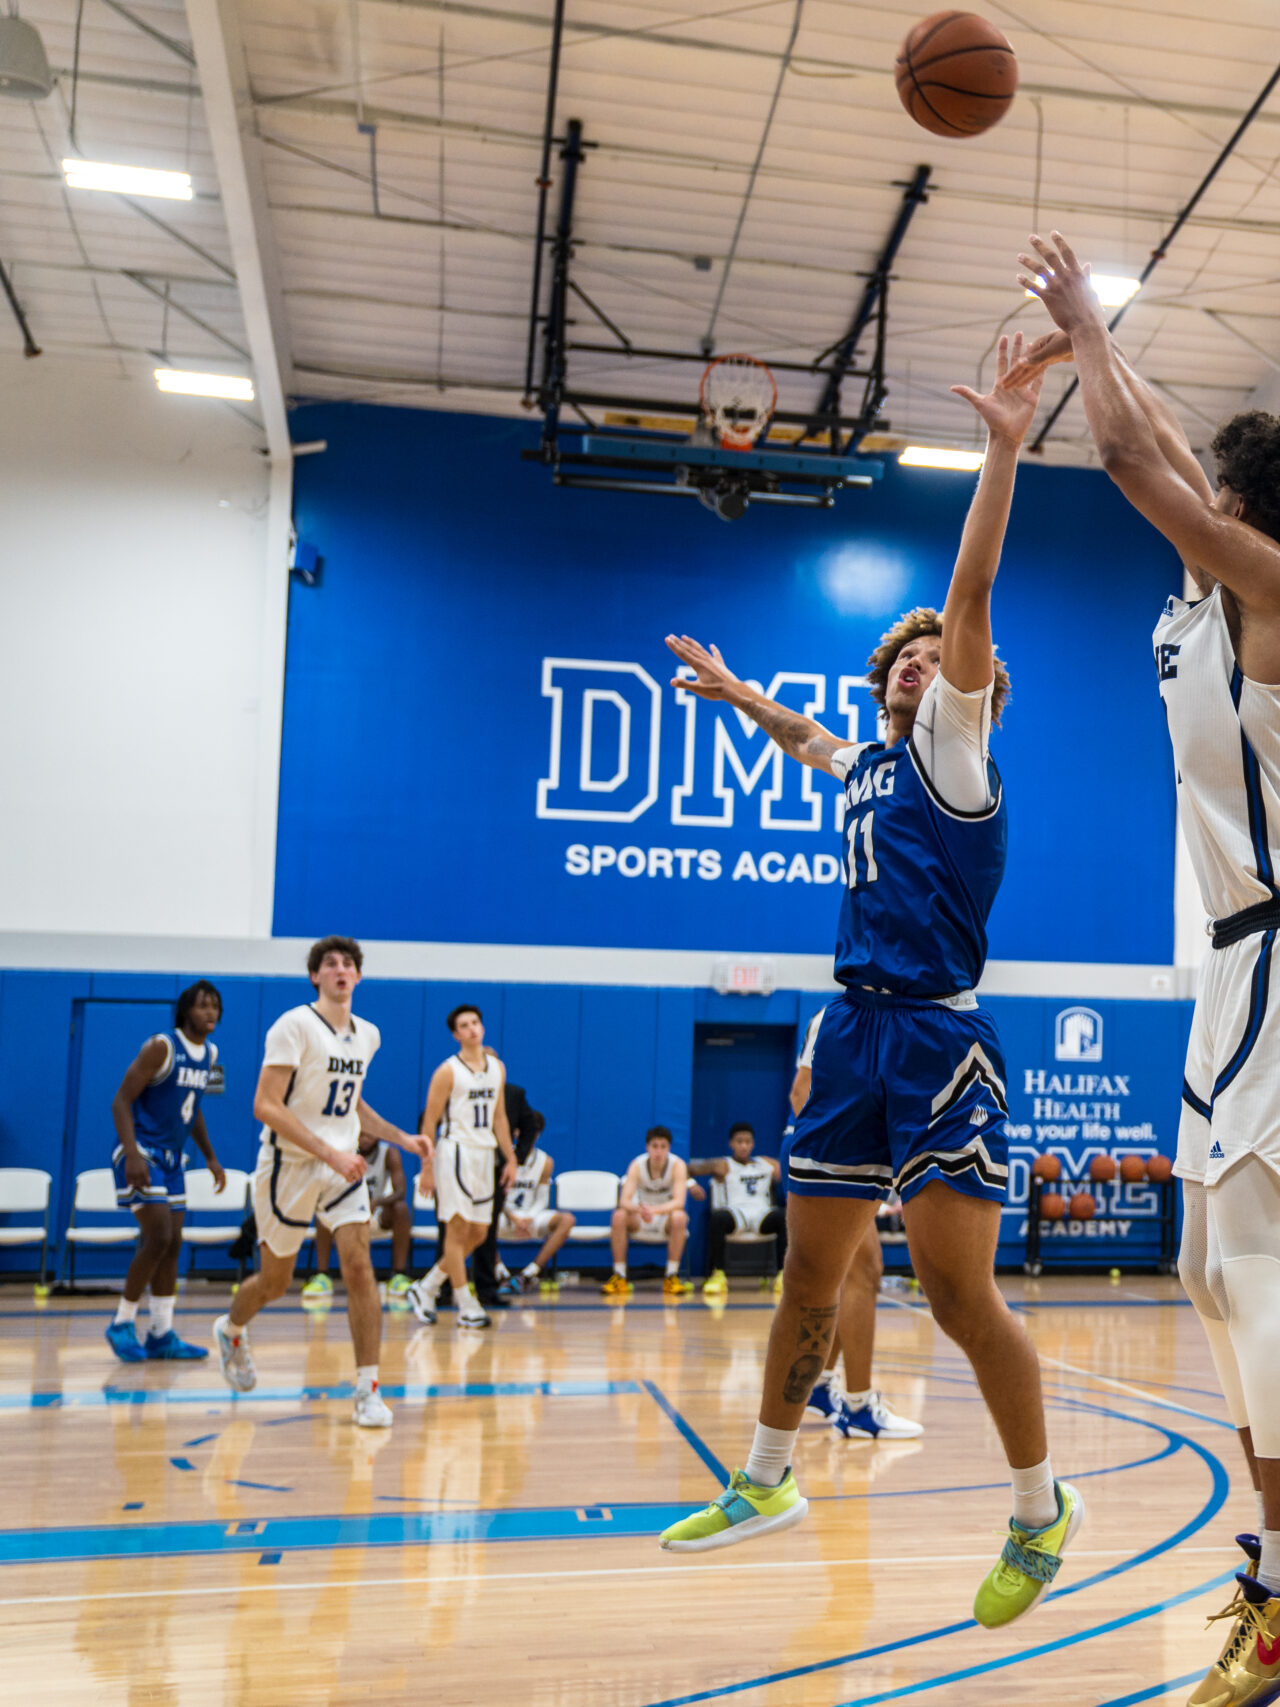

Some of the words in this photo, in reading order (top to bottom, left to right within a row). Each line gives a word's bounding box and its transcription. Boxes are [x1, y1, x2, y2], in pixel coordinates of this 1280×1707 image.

[565, 843, 722, 881] SPORTS
[847, 809, 878, 890] 11
[327, 1056, 364, 1076] DME
[1024, 1068, 1131, 1097] HALIFAX
[180, 1090, 196, 1124] 4
[321, 1079, 356, 1117] 13
[1033, 1098, 1121, 1122] HEALTH
[473, 1103, 488, 1128] 11
[1003, 1122, 1032, 1140] ive
[1035, 1124, 1080, 1144] your
[1082, 1121, 1111, 1140] life
[1114, 1122, 1158, 1141] well.
